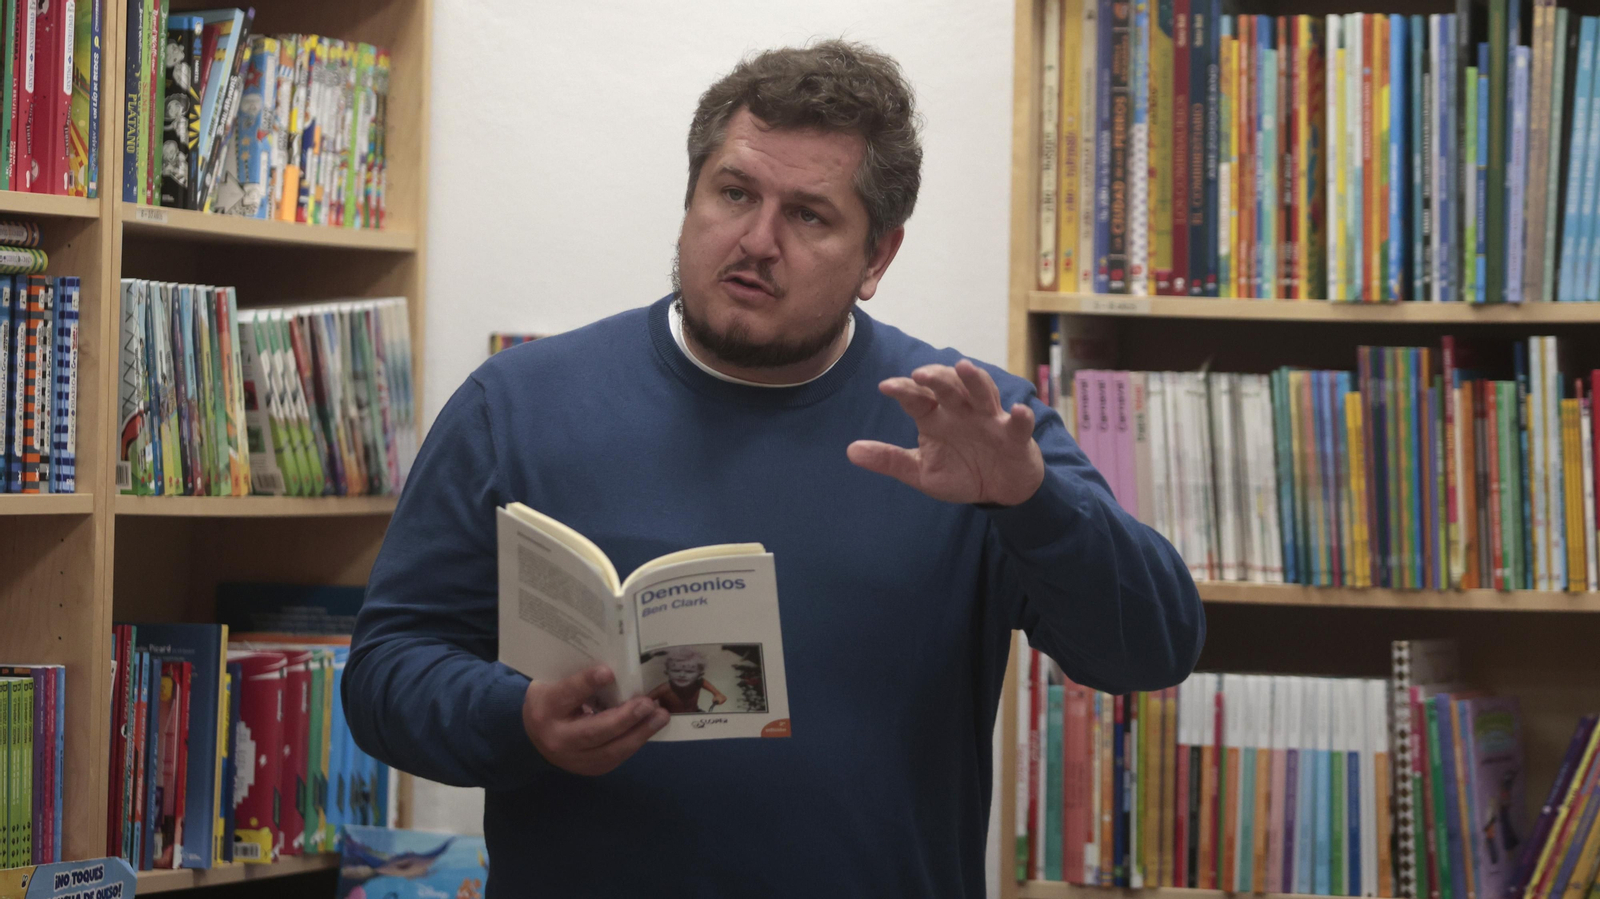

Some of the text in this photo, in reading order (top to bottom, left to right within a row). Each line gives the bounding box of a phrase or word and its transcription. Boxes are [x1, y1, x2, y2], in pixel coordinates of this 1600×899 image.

[642, 577, 746, 605] Demonios
[642, 596, 708, 618] Ben Clark
[55, 866, 103, 890] ¡NO TOQUES
[96, 884, 122, 899] QUESO!
